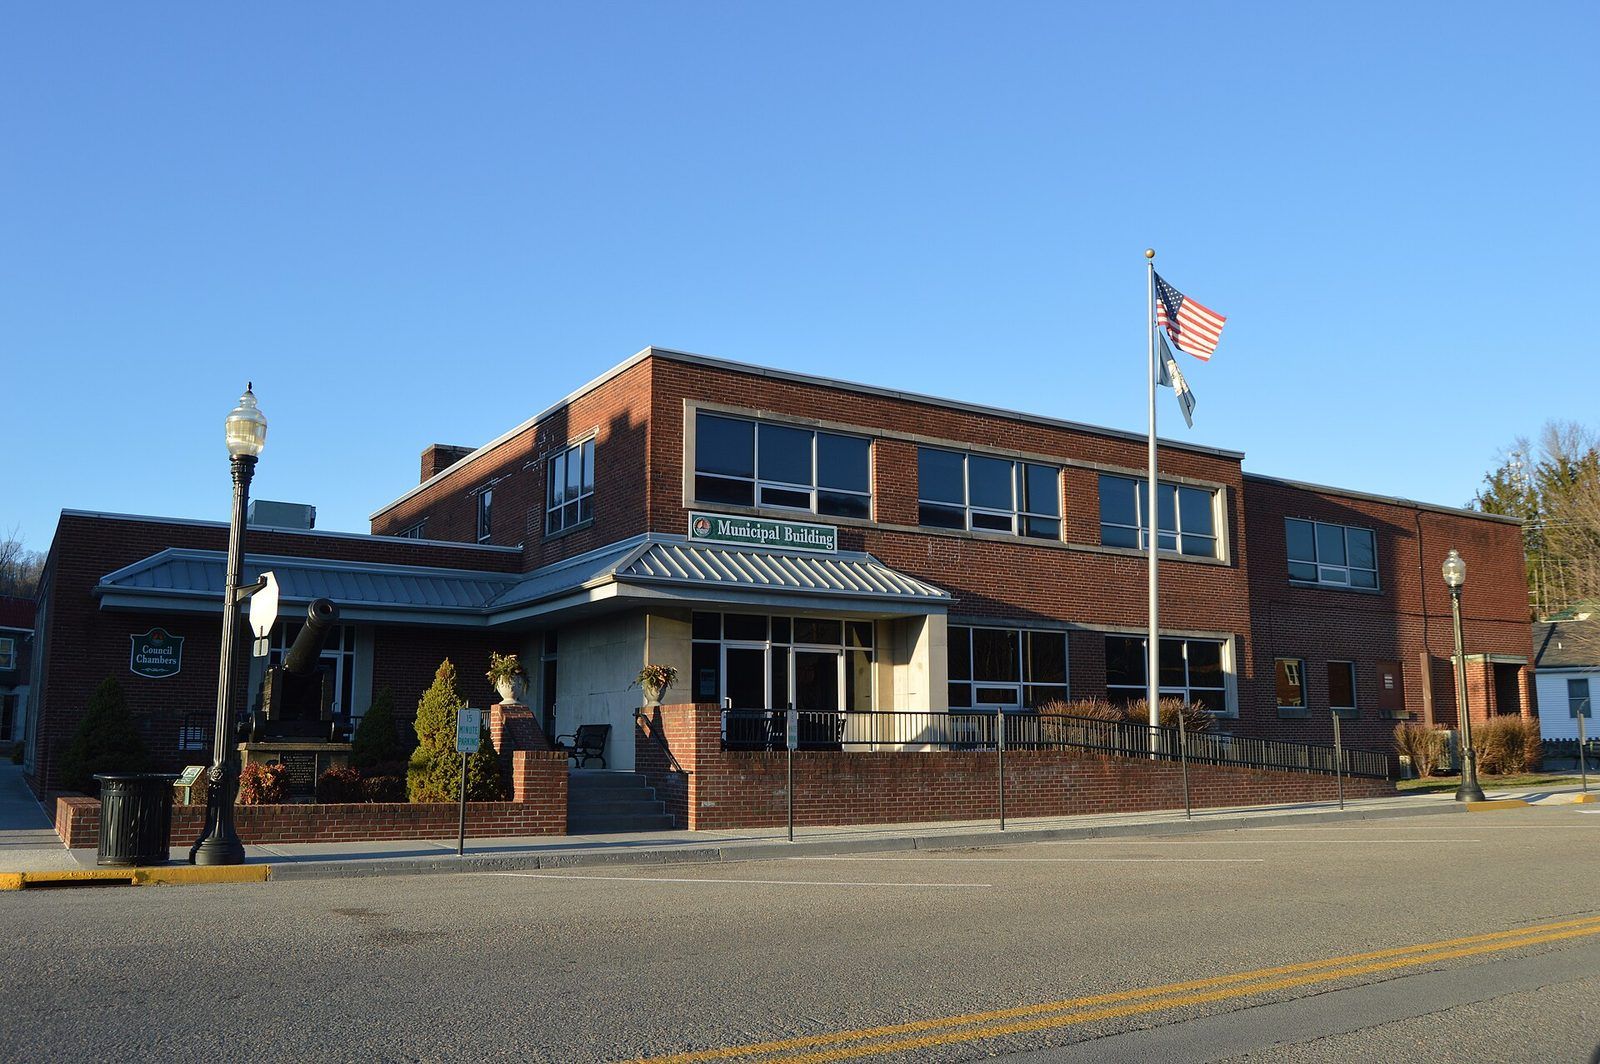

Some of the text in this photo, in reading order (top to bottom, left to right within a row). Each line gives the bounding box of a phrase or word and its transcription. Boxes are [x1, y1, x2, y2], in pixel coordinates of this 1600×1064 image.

[717, 519, 834, 549] Municipal Building
[142, 644, 173, 655] Council
[136, 654, 177, 664] Chambers
[466, 714, 473, 723] 15
